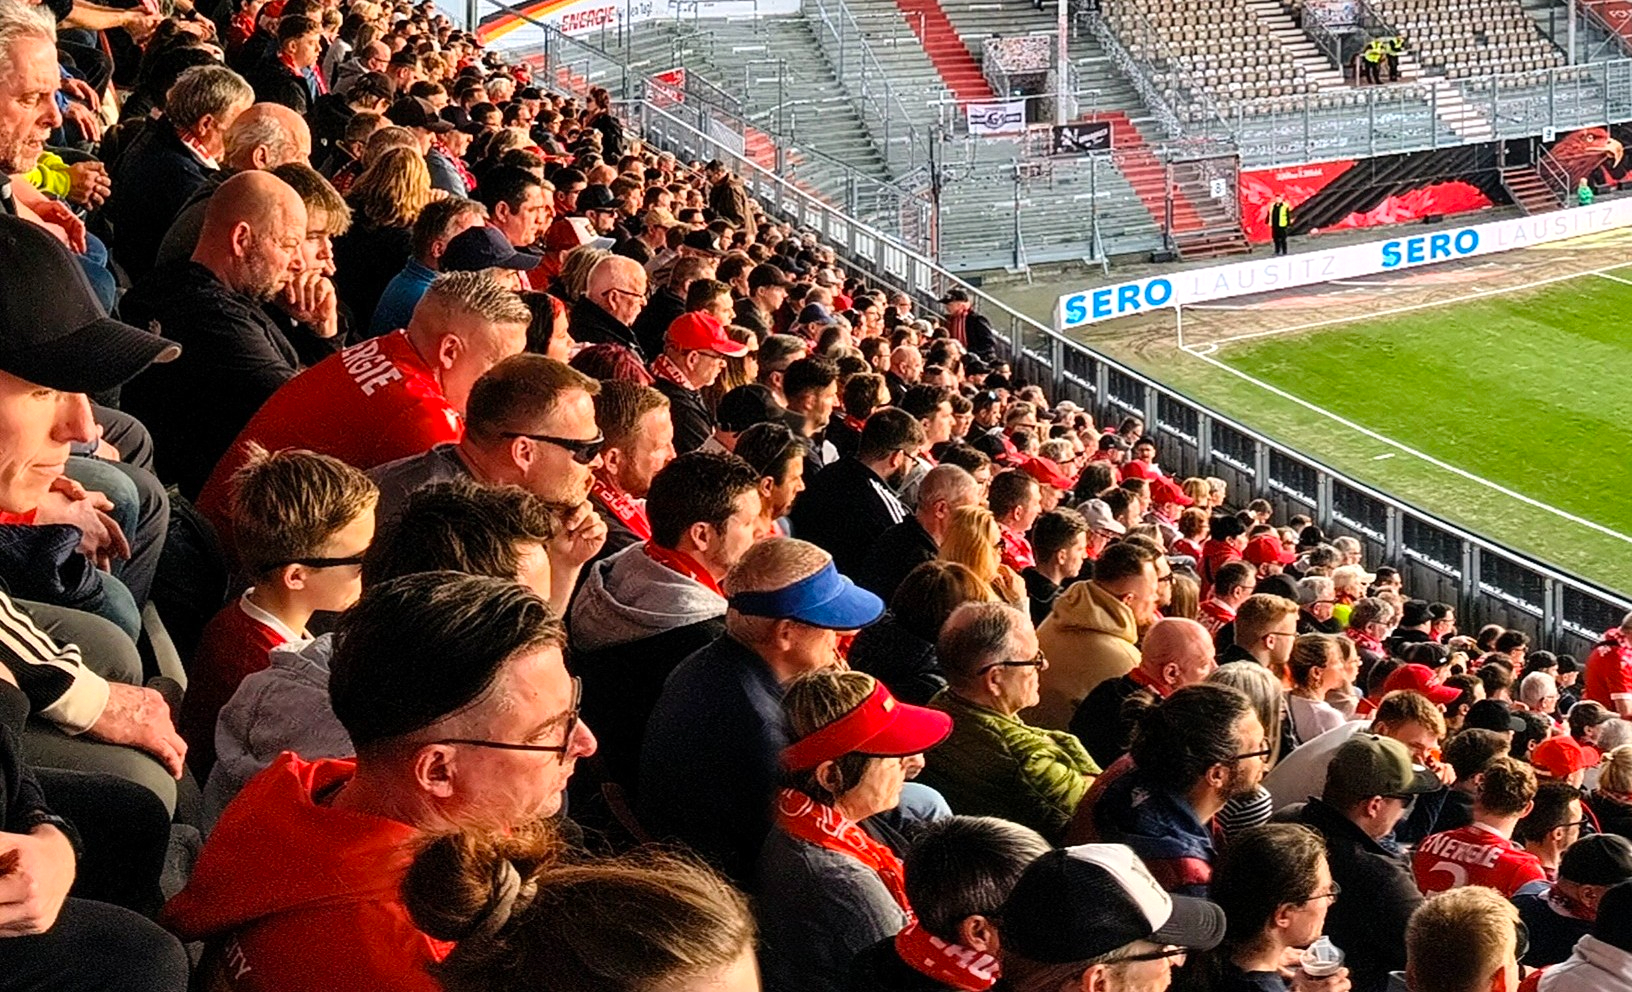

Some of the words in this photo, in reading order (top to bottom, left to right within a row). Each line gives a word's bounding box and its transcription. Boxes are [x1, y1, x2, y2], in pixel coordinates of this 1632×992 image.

[561, 5, 616, 33] ENERGIE
[1497, 206, 1614, 247] LAUSITZ
[1381, 228, 1480, 267] SERO
[1190, 254, 1336, 296] LAUSITZ
[1064, 277, 1173, 325] SERO
[1421, 827, 1503, 870] ENERGIE
